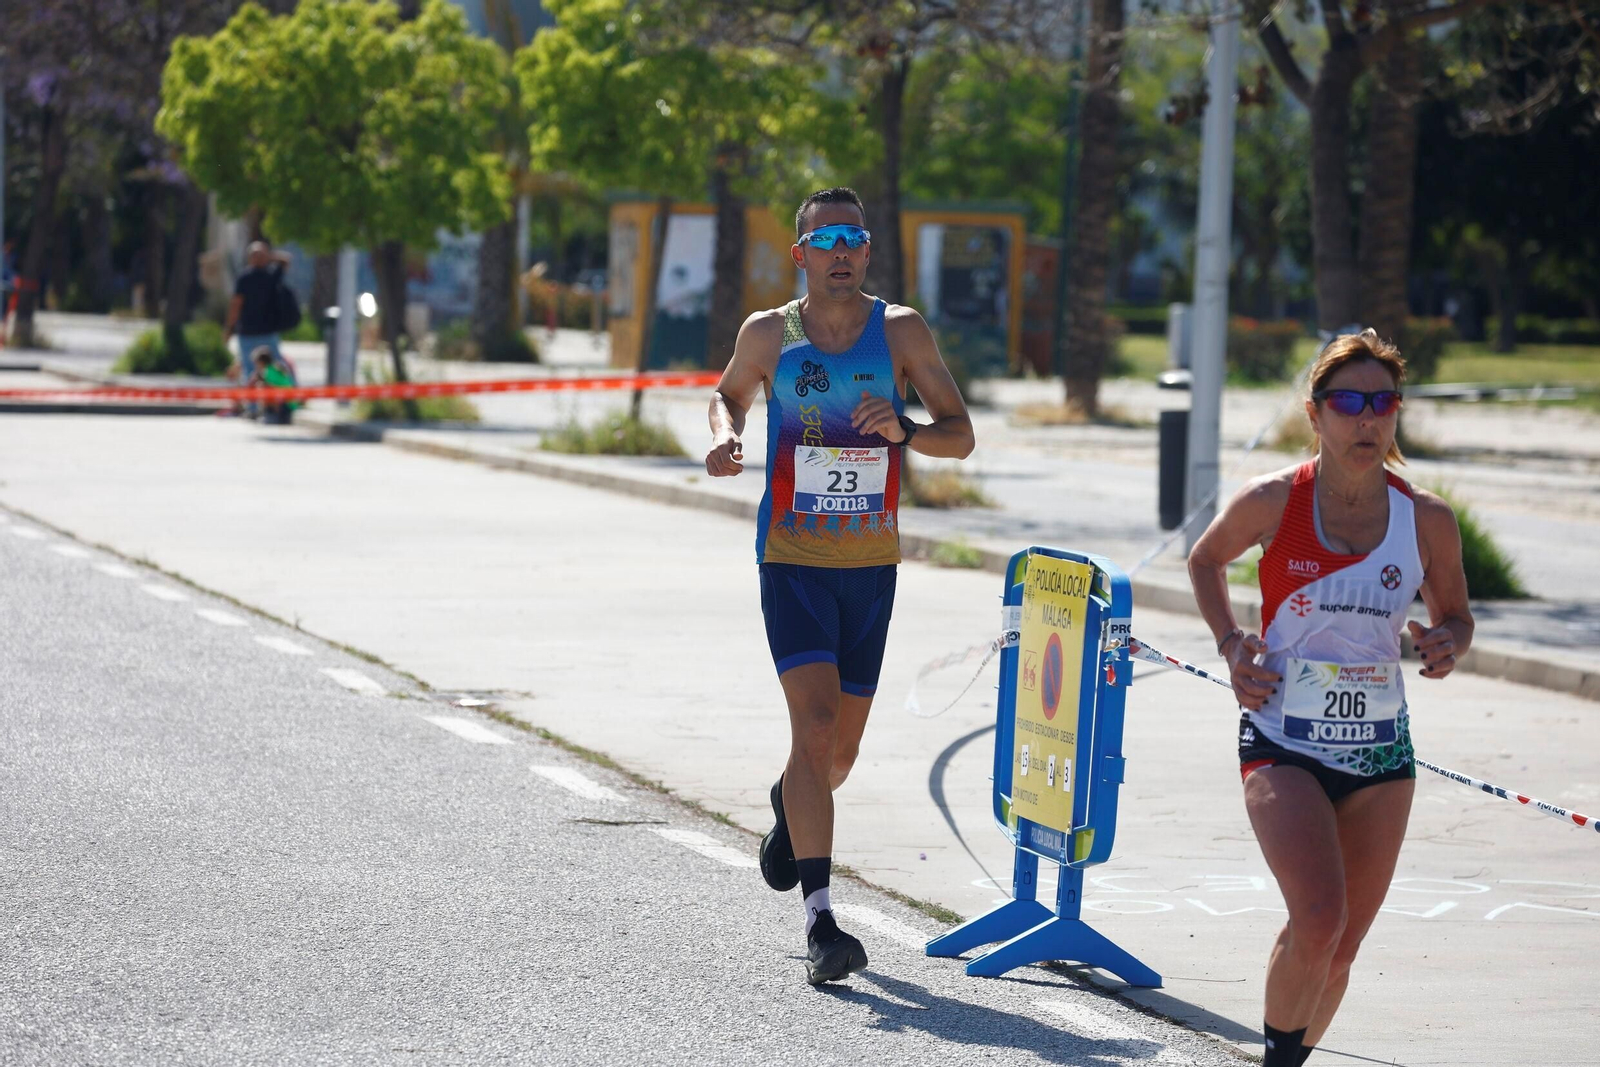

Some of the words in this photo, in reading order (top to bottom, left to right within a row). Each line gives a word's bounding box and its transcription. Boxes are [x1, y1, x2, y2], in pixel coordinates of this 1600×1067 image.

[826, 470, 859, 493] 23
[1288, 559, 1320, 573] SALTO
[1035, 568, 1062, 593] POLICÍA
[1063, 574, 1087, 599] LOCAL
[1042, 601, 1072, 630] MÁLAGA
[1319, 603, 1355, 614] super
[1323, 690, 1367, 719] 206
[1035, 723, 1059, 740] ESTACIONAR
[1060, 730, 1074, 745] DESDE
[1064, 766, 1069, 783] 3
